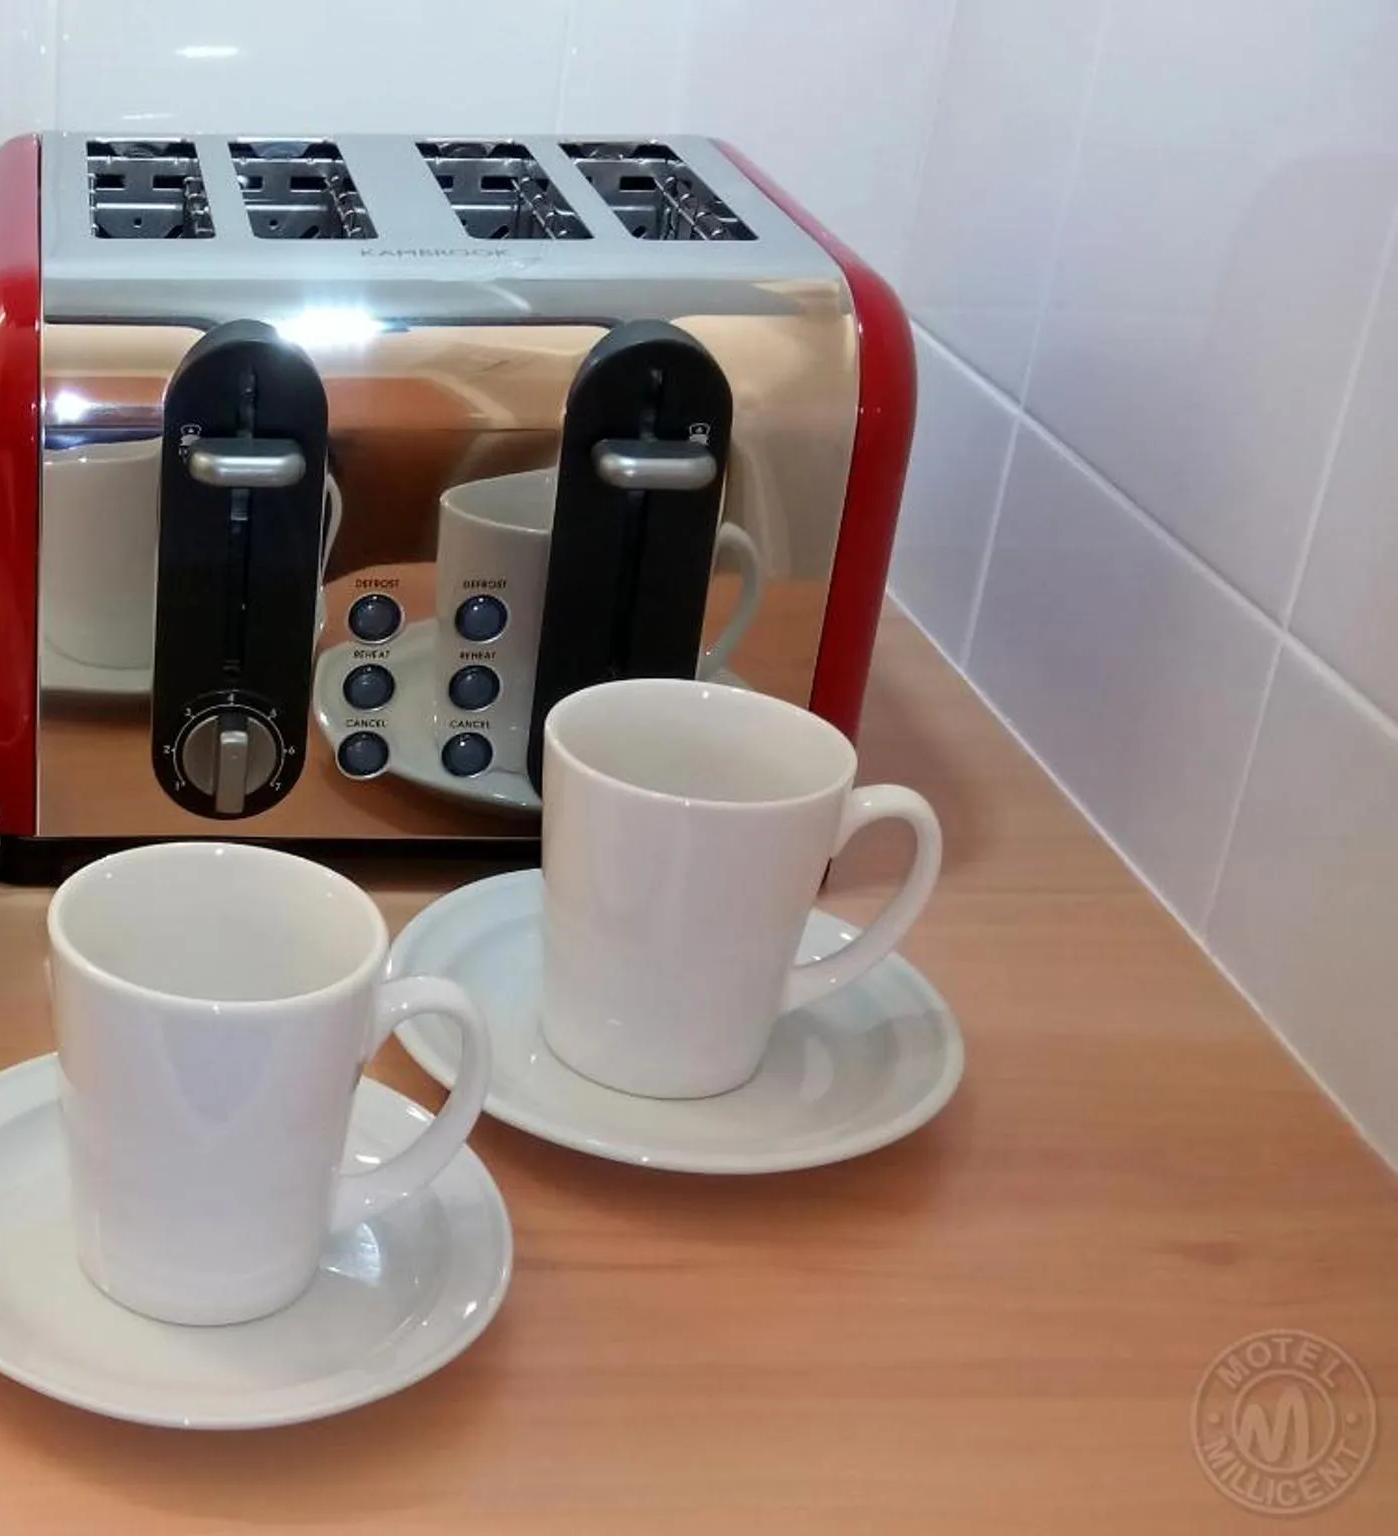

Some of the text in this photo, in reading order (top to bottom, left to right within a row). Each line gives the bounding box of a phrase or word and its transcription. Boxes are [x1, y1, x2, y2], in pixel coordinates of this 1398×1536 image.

[360, 248, 509, 257] KAMBROOK
[355, 578, 401, 590] DEFROST
[463, 578, 508, 590] DEFROST
[353, 650, 390, 660] REHEAT
[460, 651, 497, 660] REHEAT
[346, 719, 388, 729] CANCEL
[450, 719, 491, 729] CANCEL
